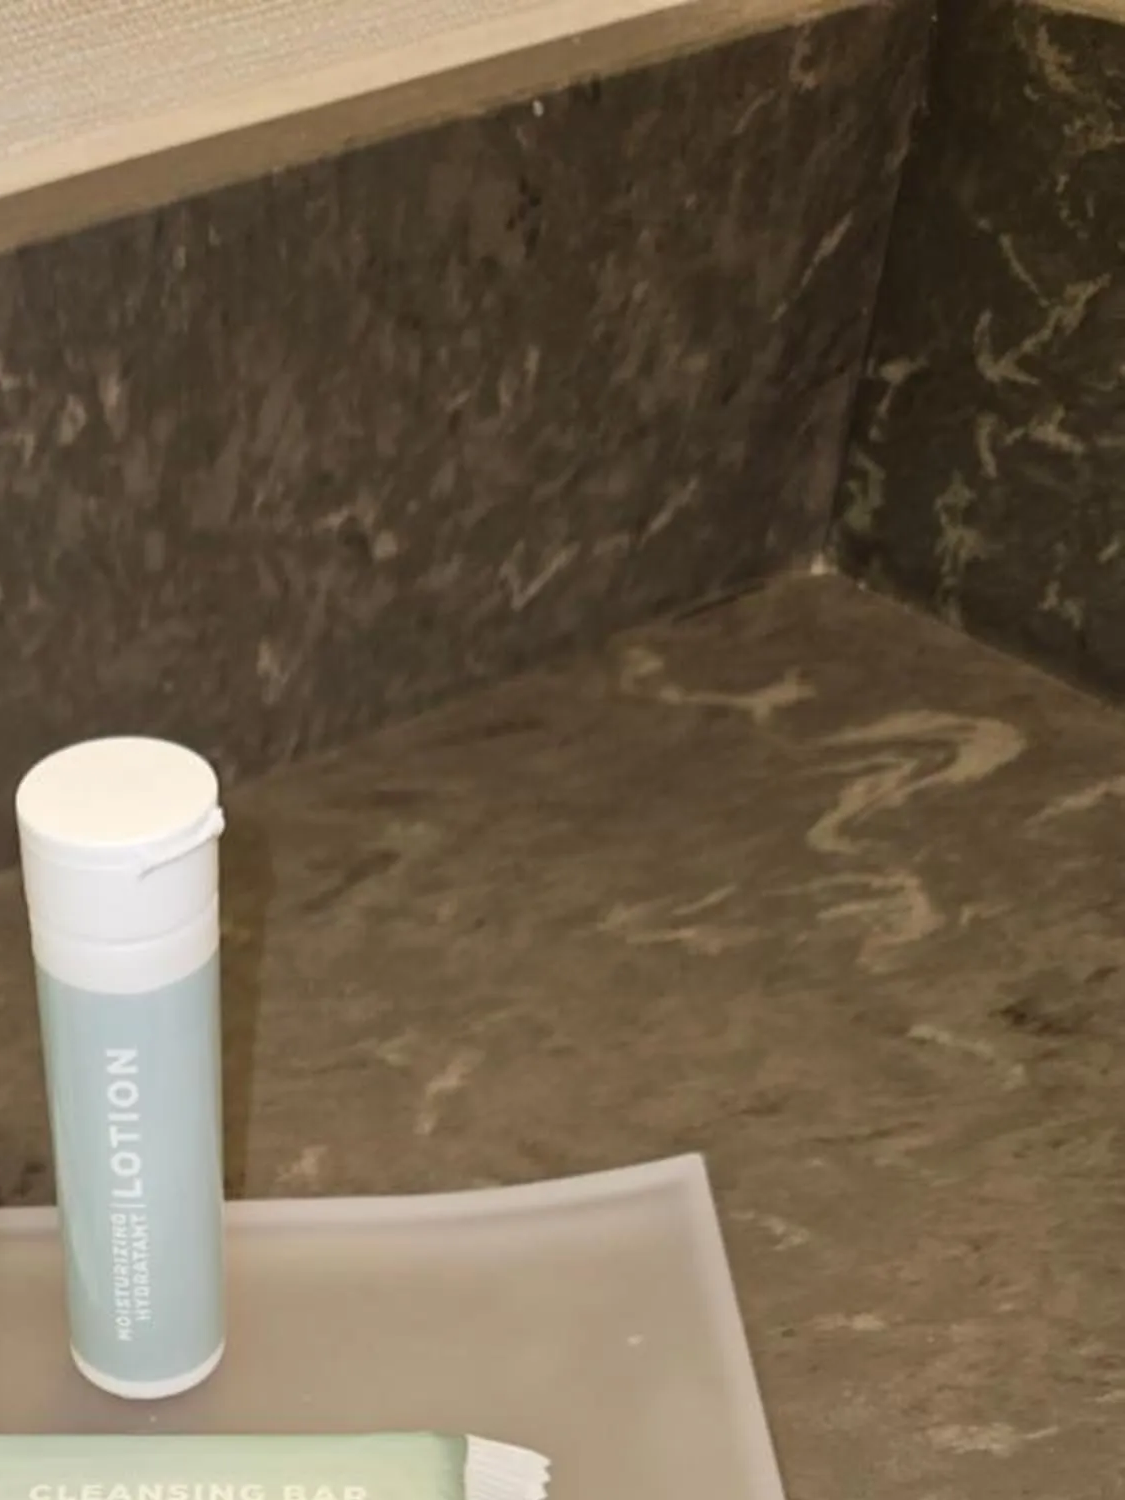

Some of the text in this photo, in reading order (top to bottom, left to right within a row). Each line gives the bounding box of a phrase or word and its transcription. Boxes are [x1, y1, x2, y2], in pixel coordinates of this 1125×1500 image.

[106, 1048, 143, 1198] LOTION
[110, 1212, 132, 1342] MOISTURIZING
[130, 1212, 152, 1321] HYDRATANT
